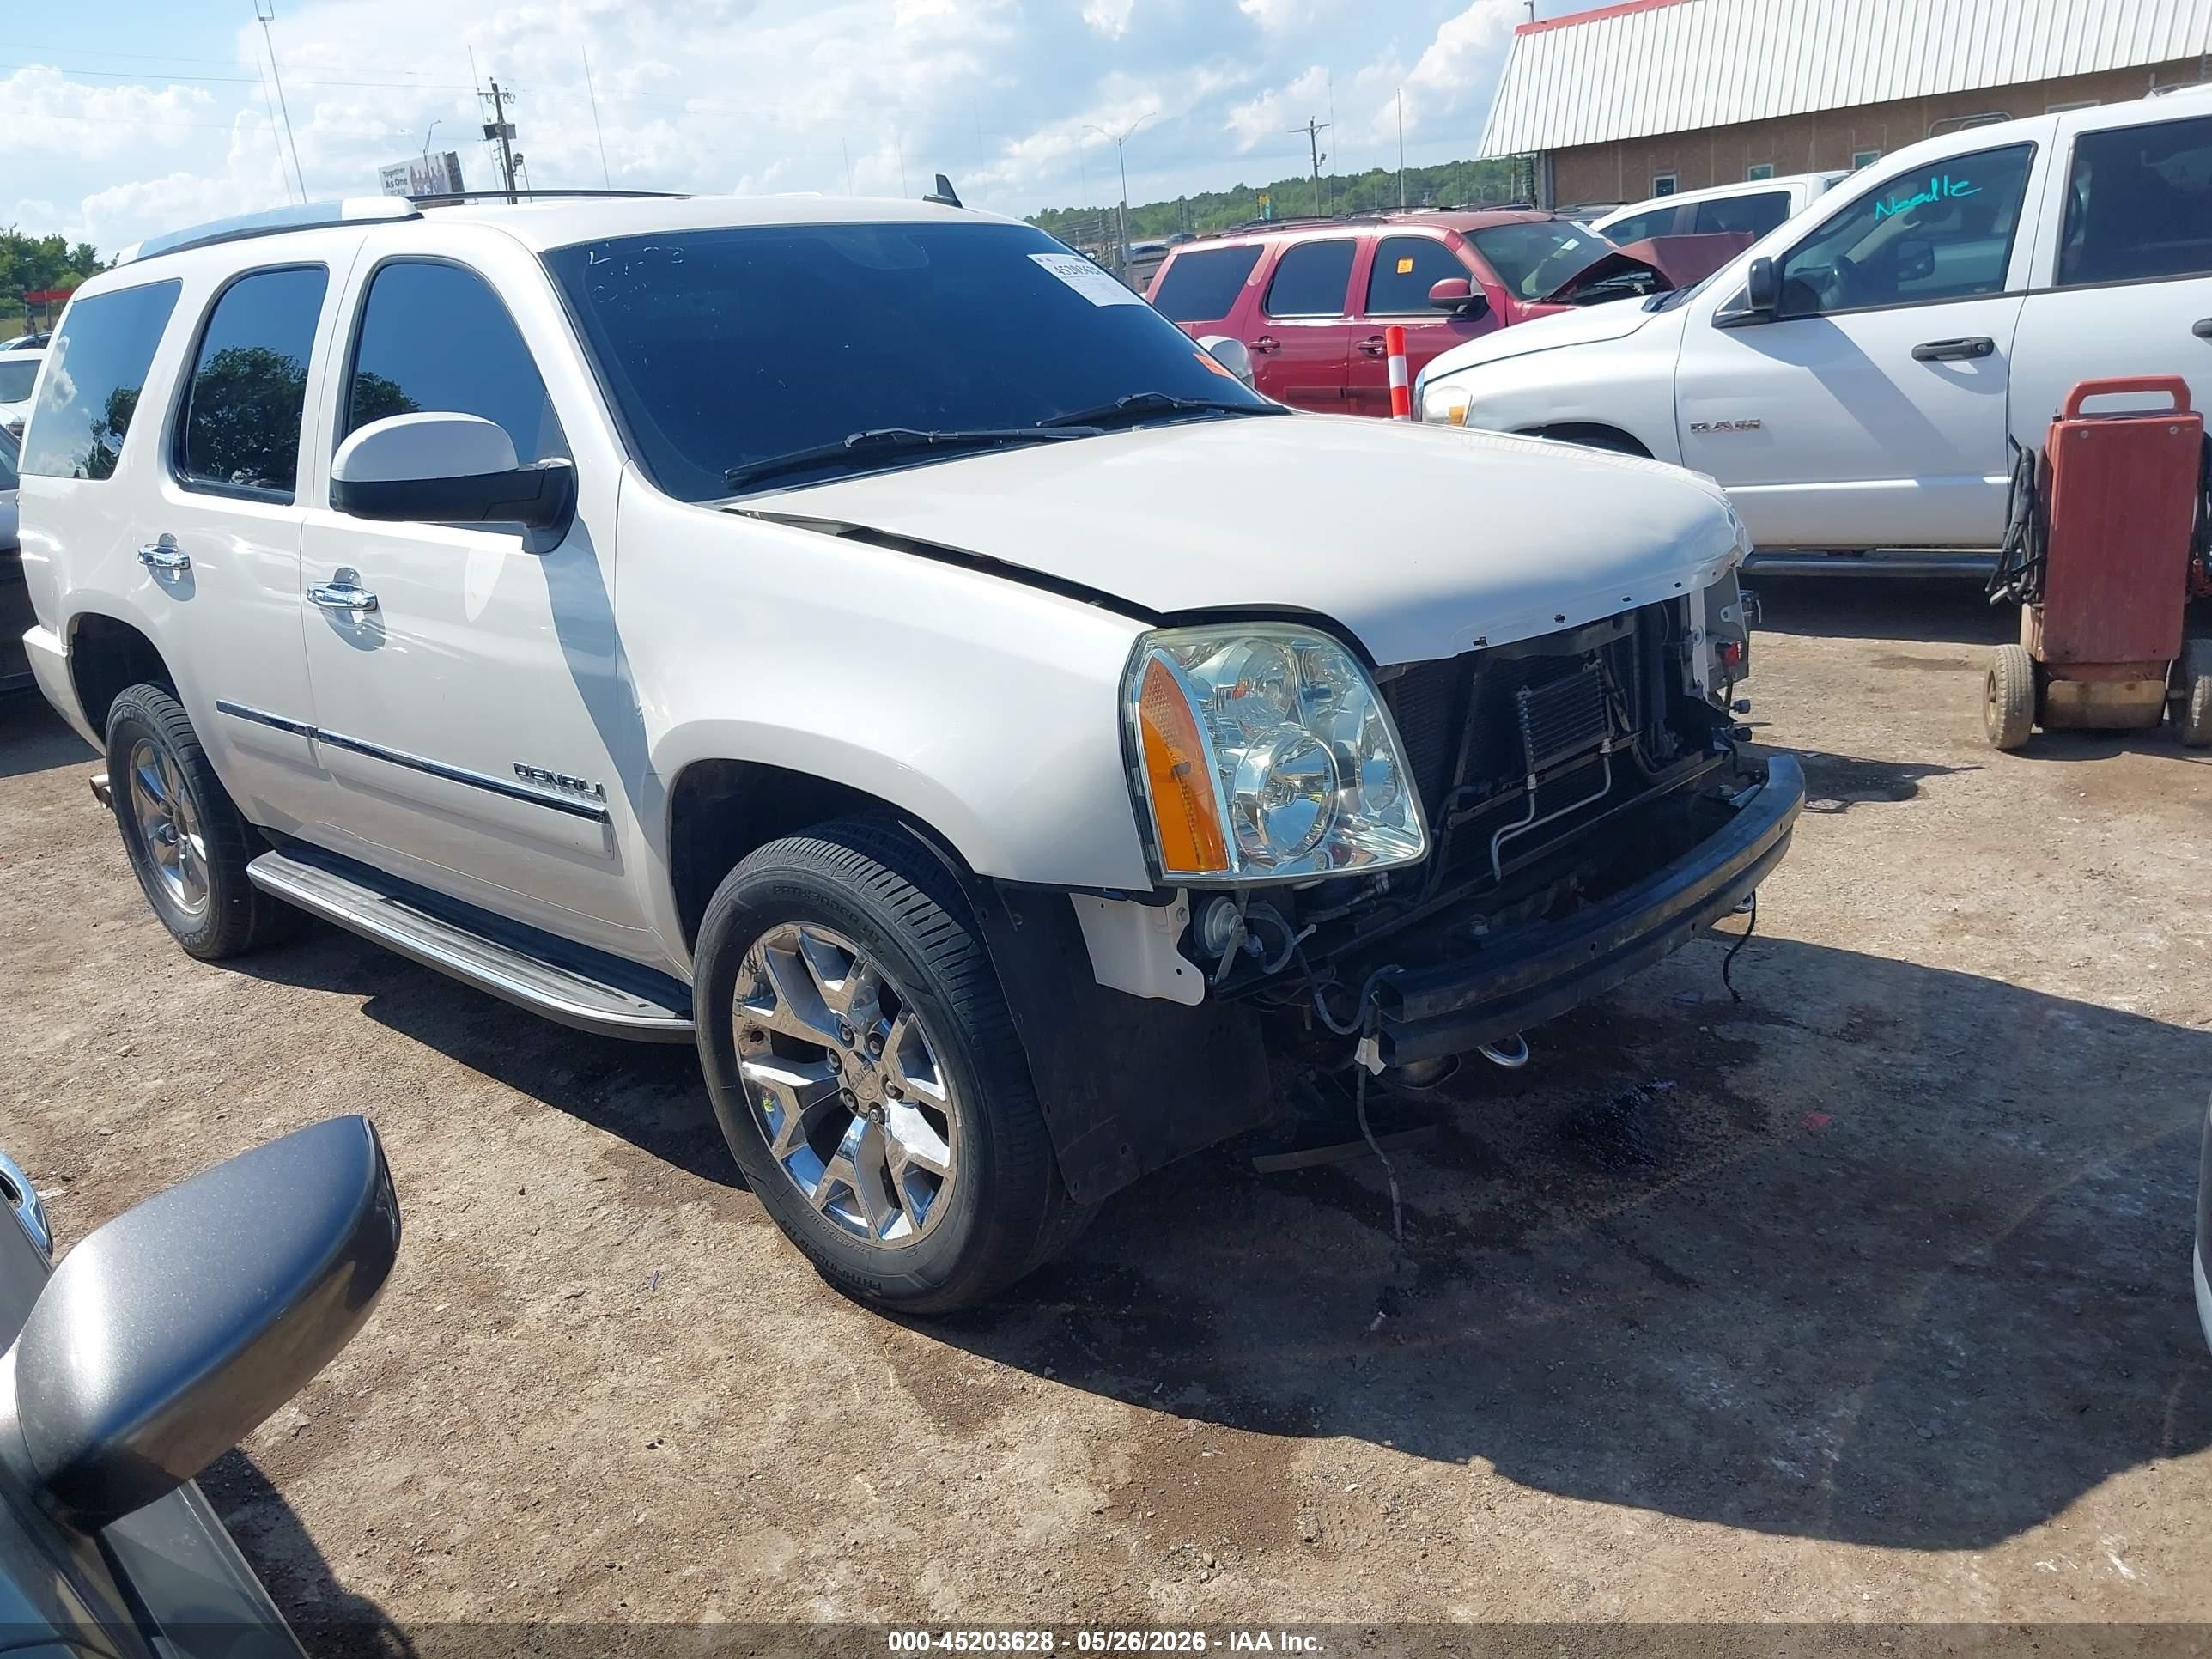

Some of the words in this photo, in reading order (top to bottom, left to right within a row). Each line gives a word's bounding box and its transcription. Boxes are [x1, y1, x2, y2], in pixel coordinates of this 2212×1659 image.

[386, 180, 394, 189] As
[395, 178, 408, 187] One
[1690, 418, 1760, 434] RAM
[513, 761, 607, 802] DENALI
